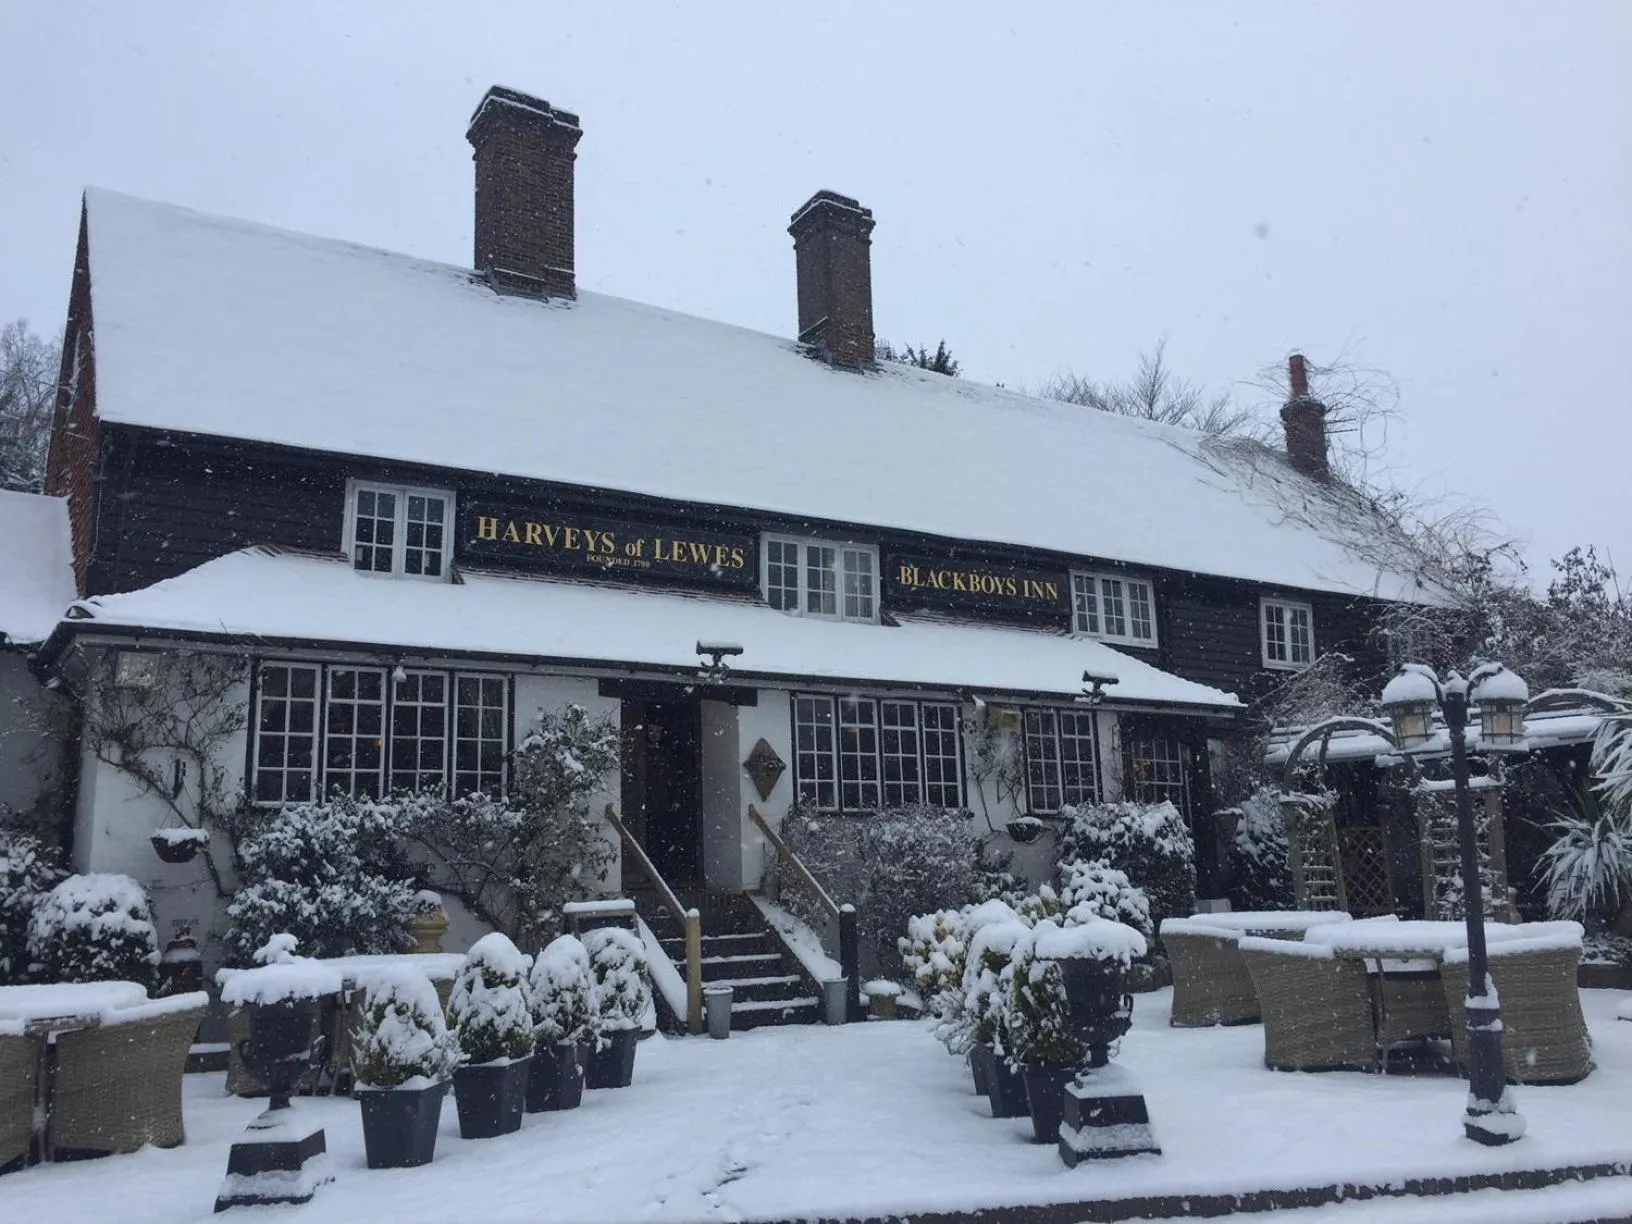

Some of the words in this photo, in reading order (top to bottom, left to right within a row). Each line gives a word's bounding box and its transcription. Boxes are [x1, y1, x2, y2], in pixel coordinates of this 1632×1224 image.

[478, 516, 615, 554] HARVEYS
[625, 539, 644, 557] of
[655, 538, 745, 569] LEWES
[900, 566, 1016, 597] BLACKBOYS
[1023, 580, 1058, 599] INN
